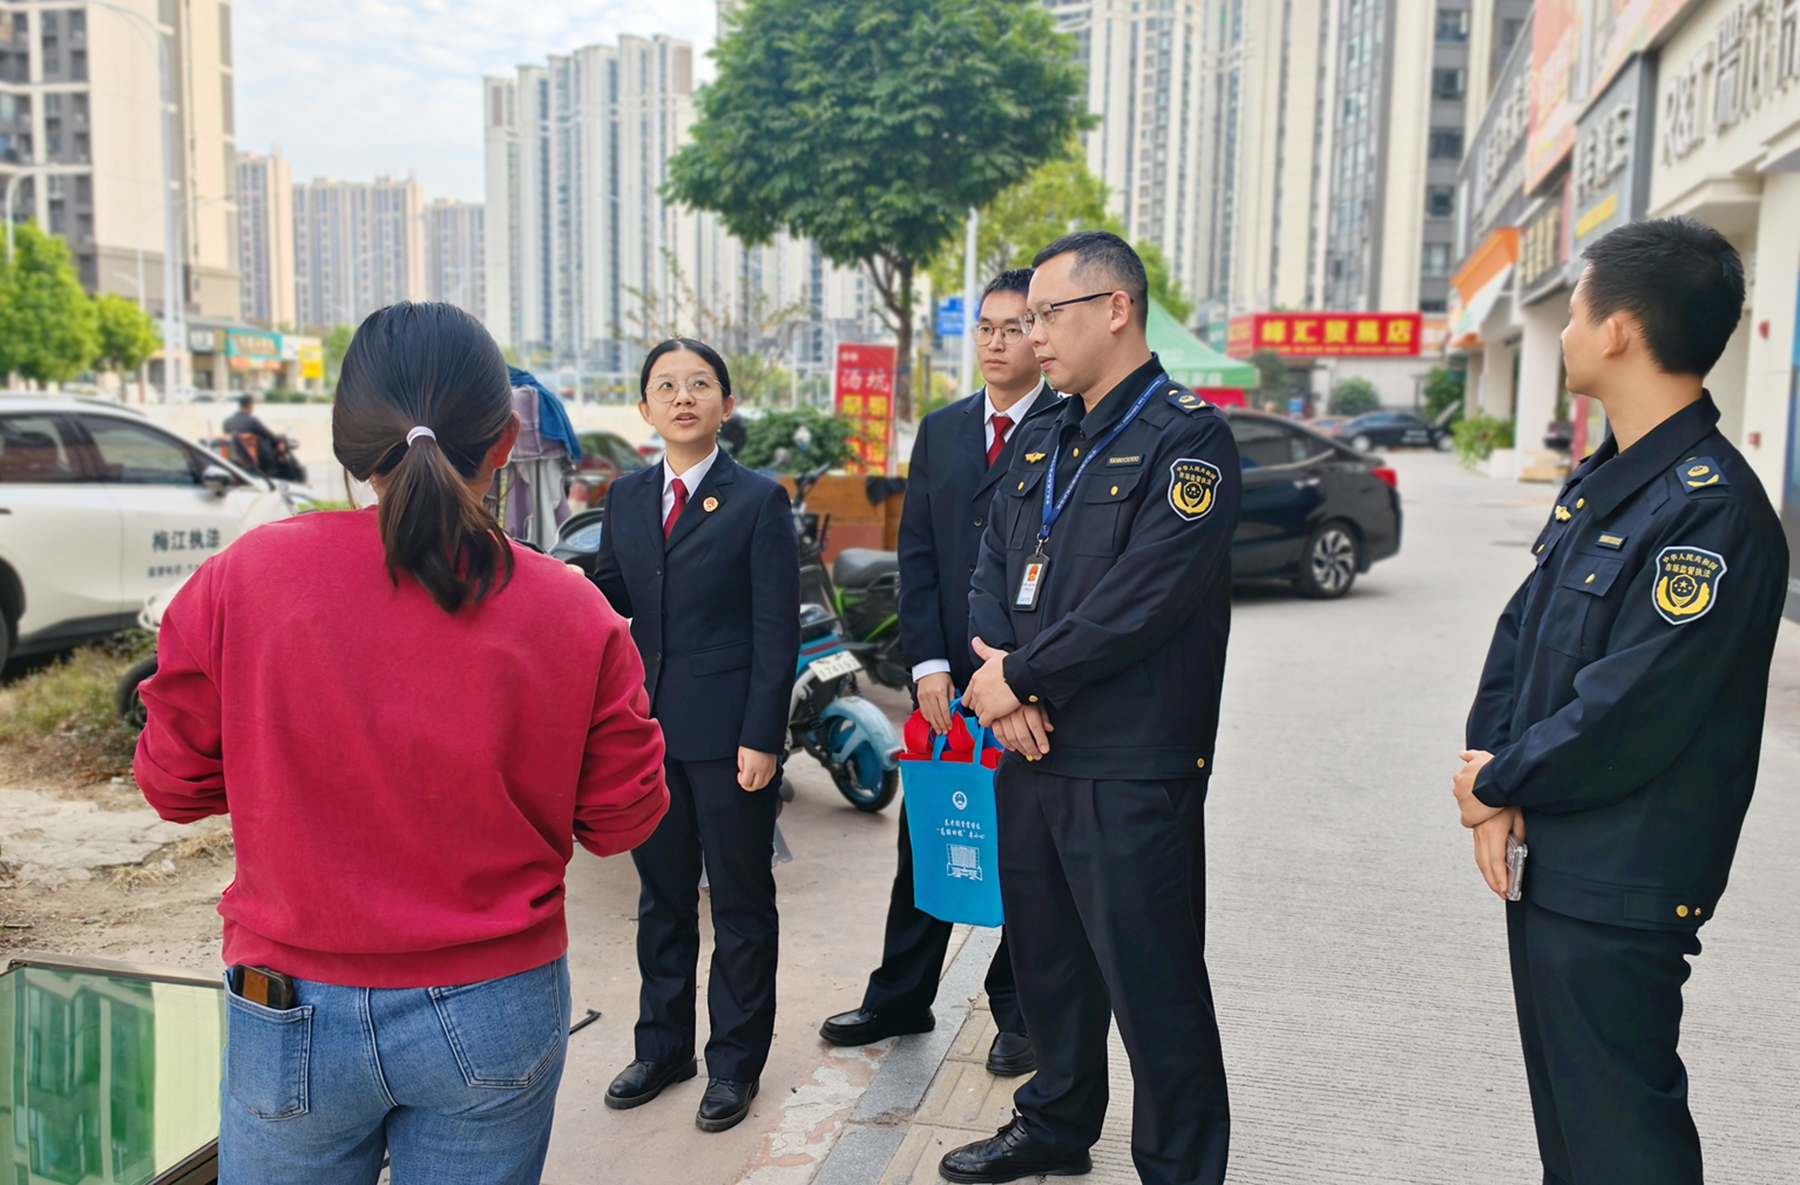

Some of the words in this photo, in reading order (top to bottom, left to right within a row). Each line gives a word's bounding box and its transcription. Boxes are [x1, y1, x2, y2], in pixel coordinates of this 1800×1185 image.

[1262, 319, 1413, 344] 峰汇贸易店
[152, 527, 220, 552] 梅江执法
[1662, 553, 1719, 571] 中华人民共和国
